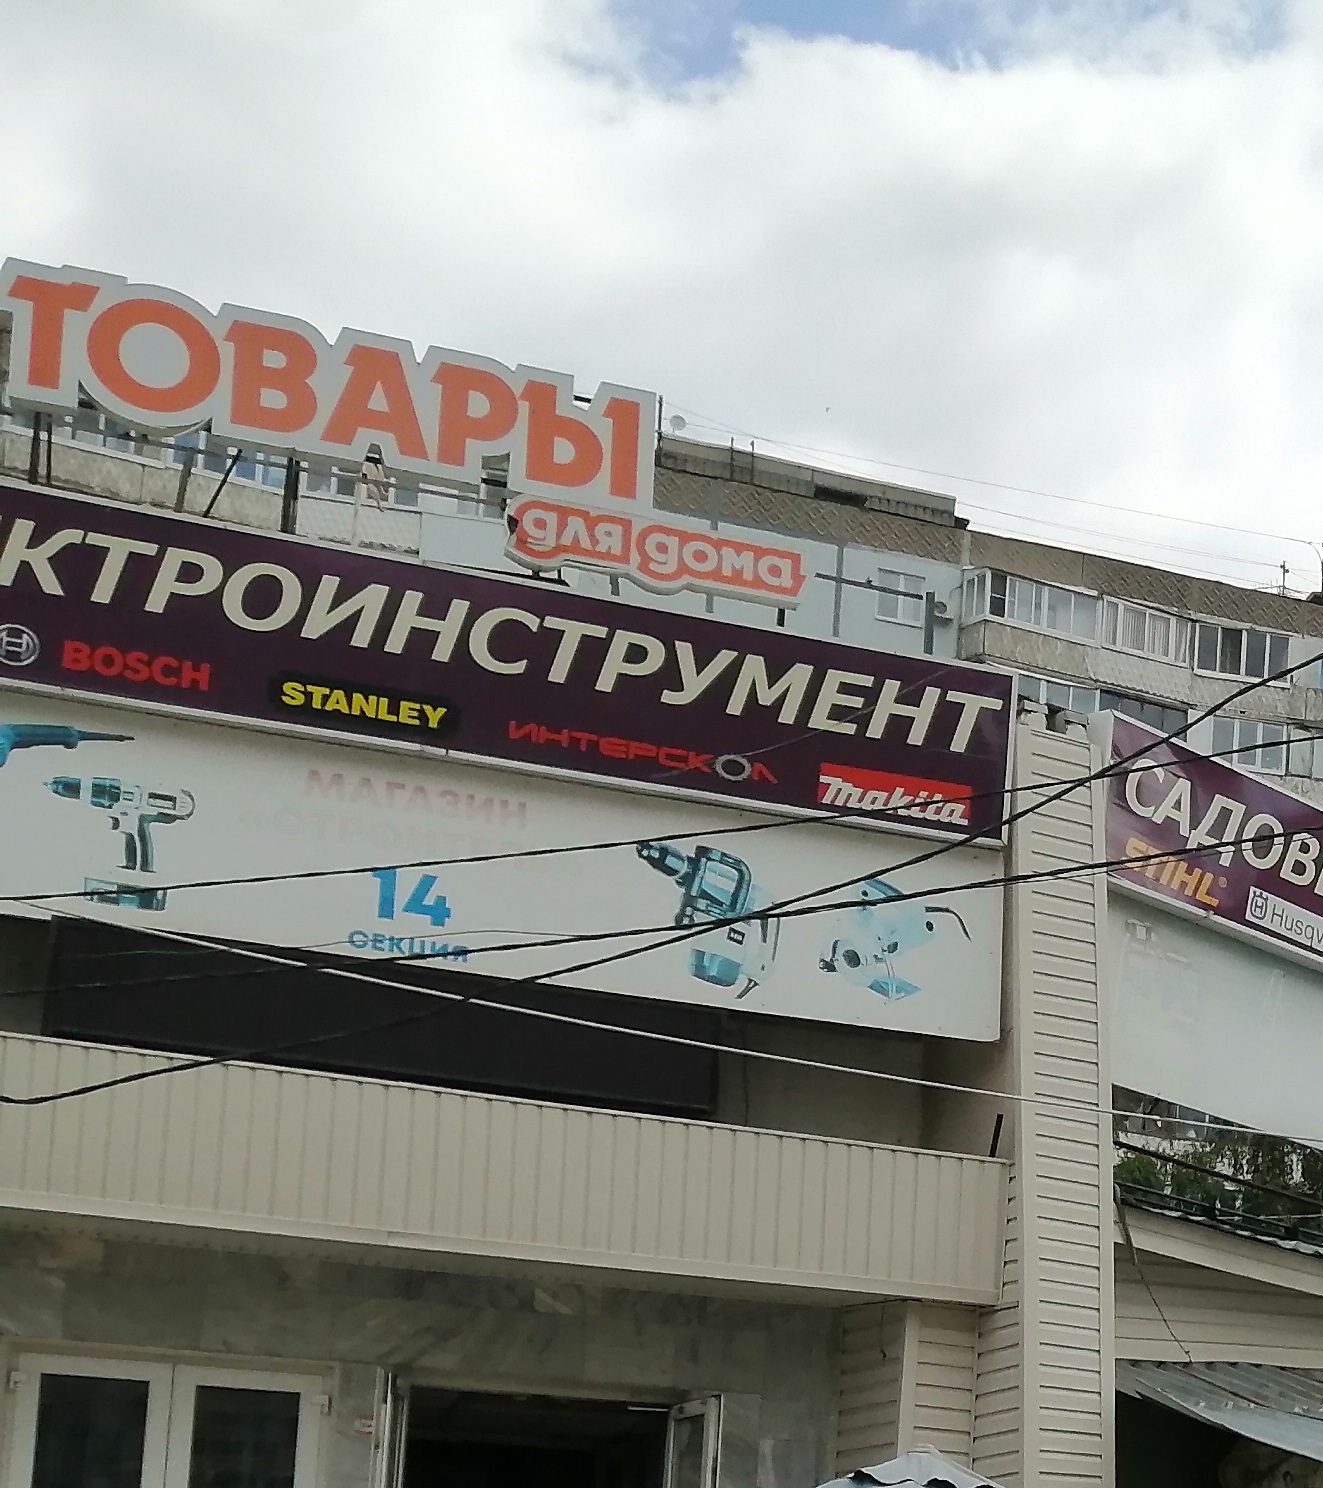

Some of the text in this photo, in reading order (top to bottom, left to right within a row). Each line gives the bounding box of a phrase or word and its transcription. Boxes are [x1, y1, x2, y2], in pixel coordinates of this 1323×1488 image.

[8, 275, 641, 499] ТОВАРЫ
[523, 510, 794, 592] для дома
[61, 640, 210, 691] BOSCH
[281, 681, 447, 729] STANLEY
[508, 720, 778, 784] ИНТЕРСКОЛ
[303, 769, 528, 830] МАГАЗИН
[373, 867, 452, 927] 14
[348, 930, 471, 963] СЕКЦИЯ
